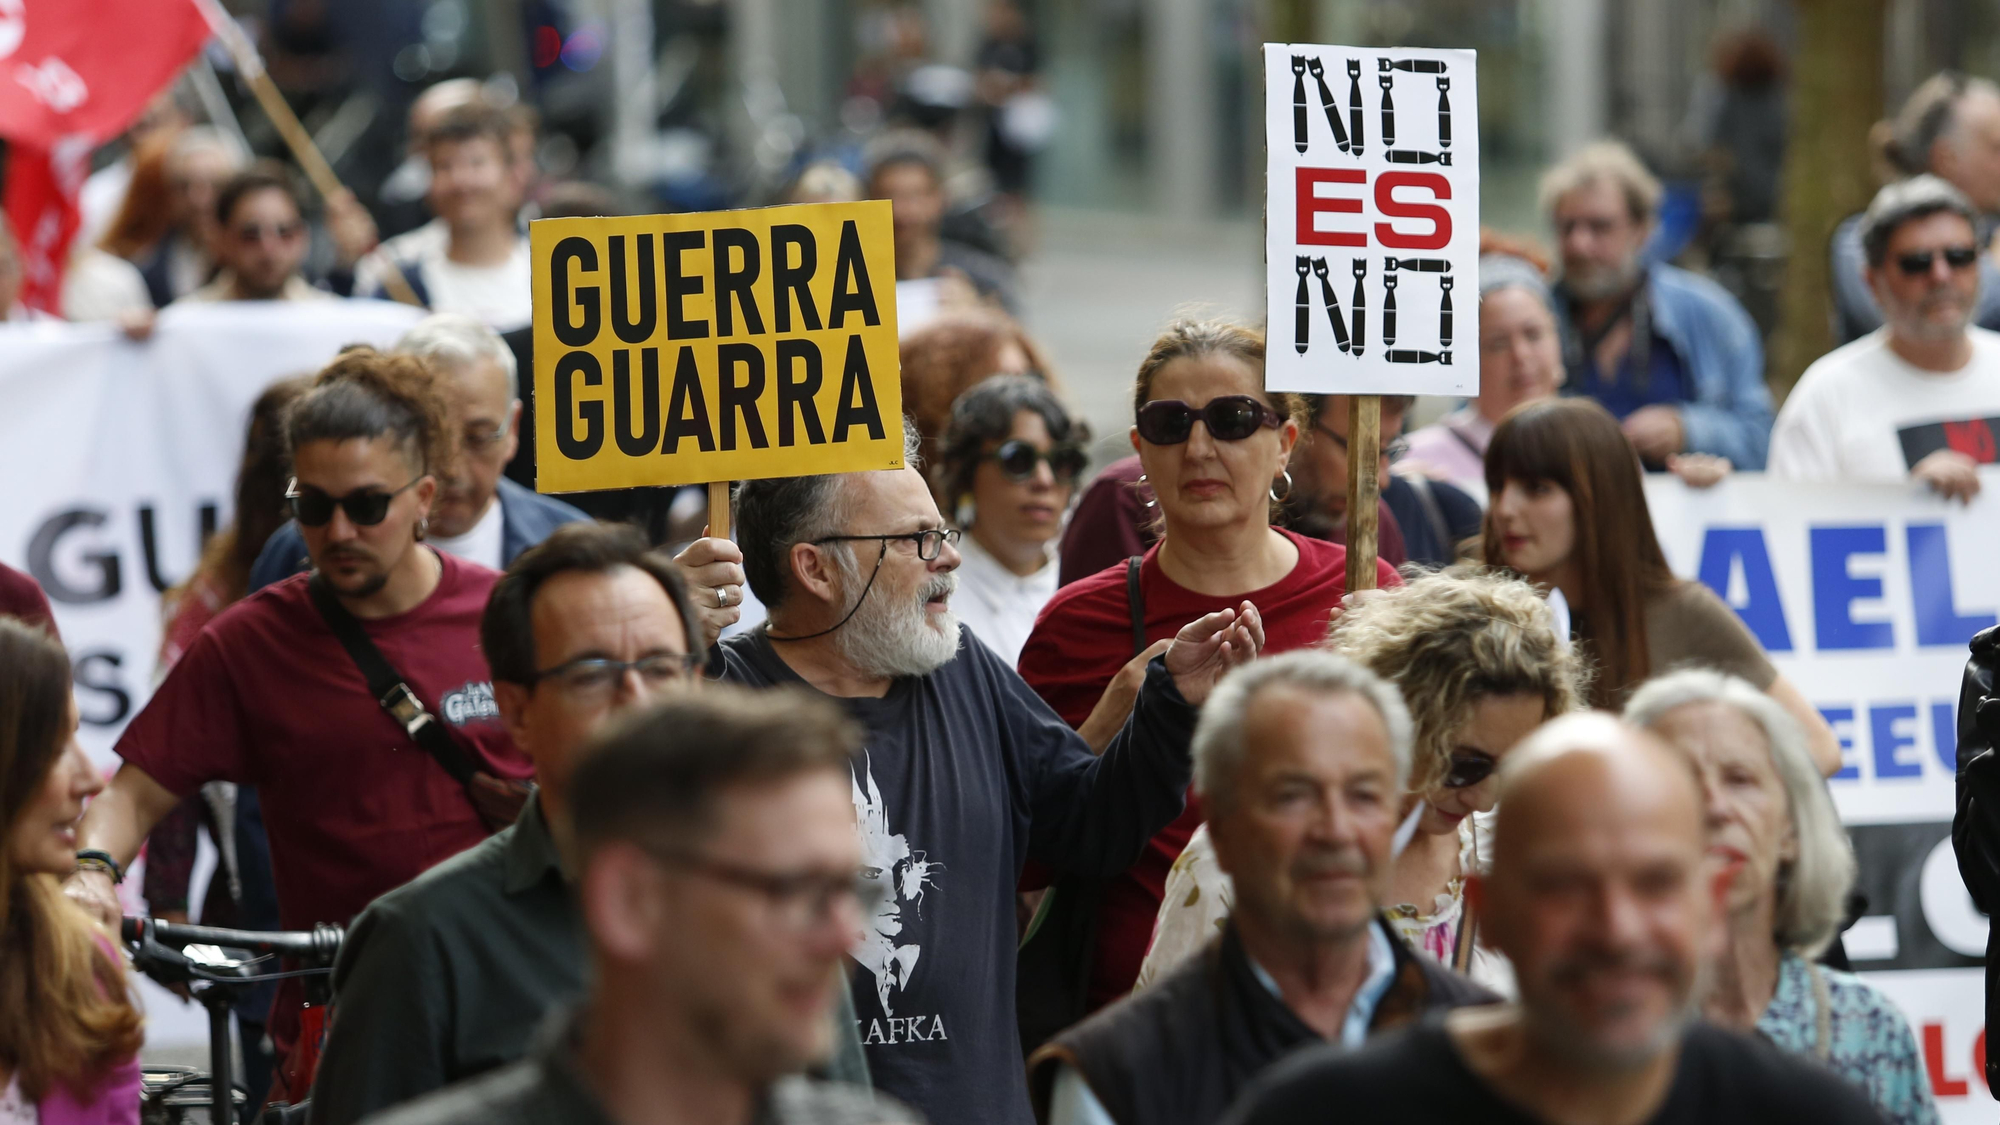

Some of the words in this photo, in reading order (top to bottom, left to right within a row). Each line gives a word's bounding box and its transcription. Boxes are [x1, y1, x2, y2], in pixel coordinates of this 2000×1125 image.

[1291, 55, 1452, 166] NO
[1296, 167, 1452, 250] ES
[551, 220, 880, 346] GUERRA
[1295, 255, 1453, 365] NO
[554, 335, 886, 460] GUARRA
